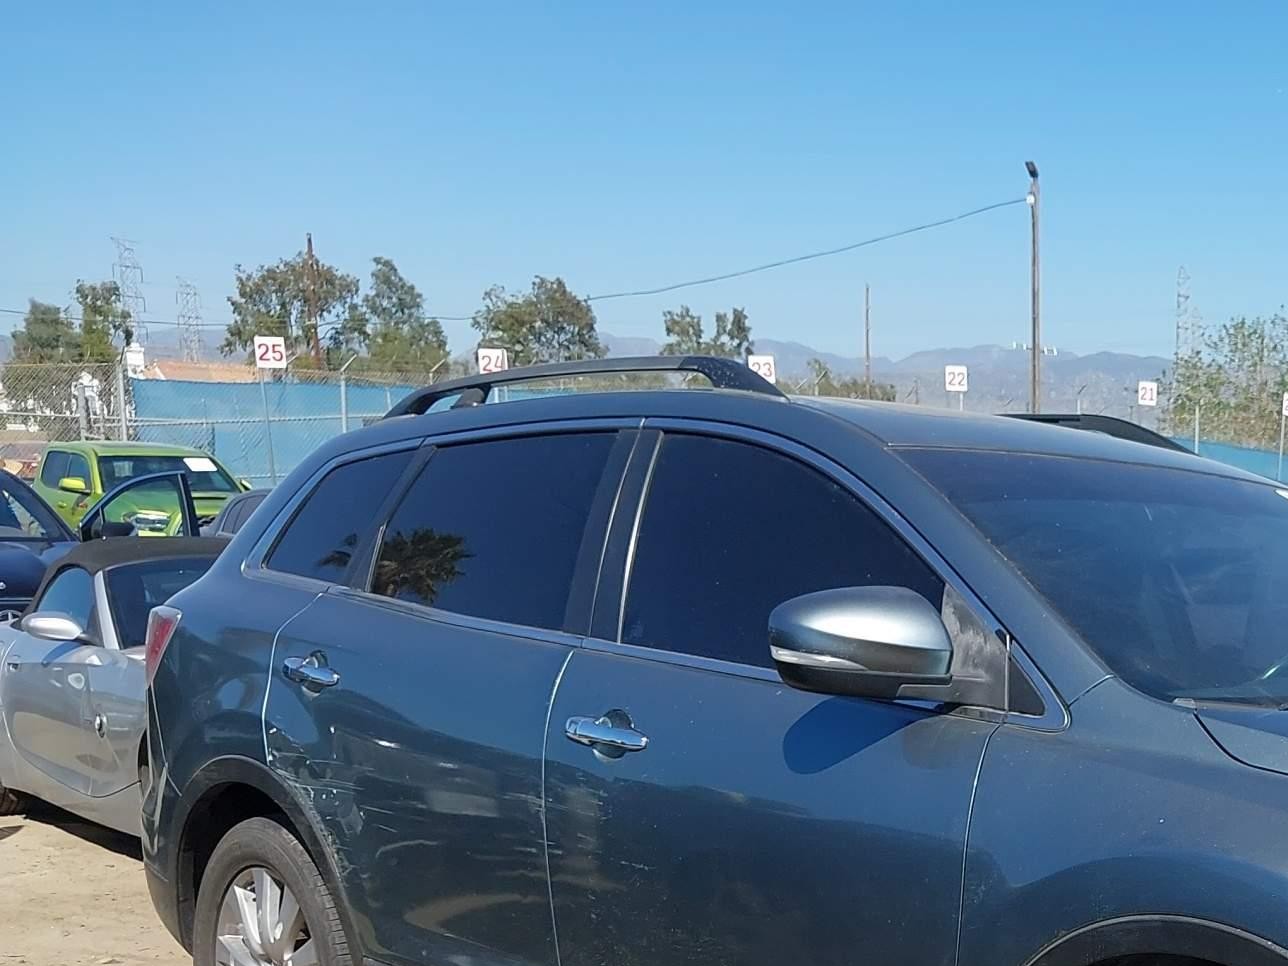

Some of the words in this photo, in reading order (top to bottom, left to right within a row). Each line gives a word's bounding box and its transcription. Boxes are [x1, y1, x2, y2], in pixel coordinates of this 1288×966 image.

[257, 342, 284, 362] 25
[481, 354, 504, 371] 24
[947, 371, 966, 387] 22
[1140, 386, 1156, 402] 21
